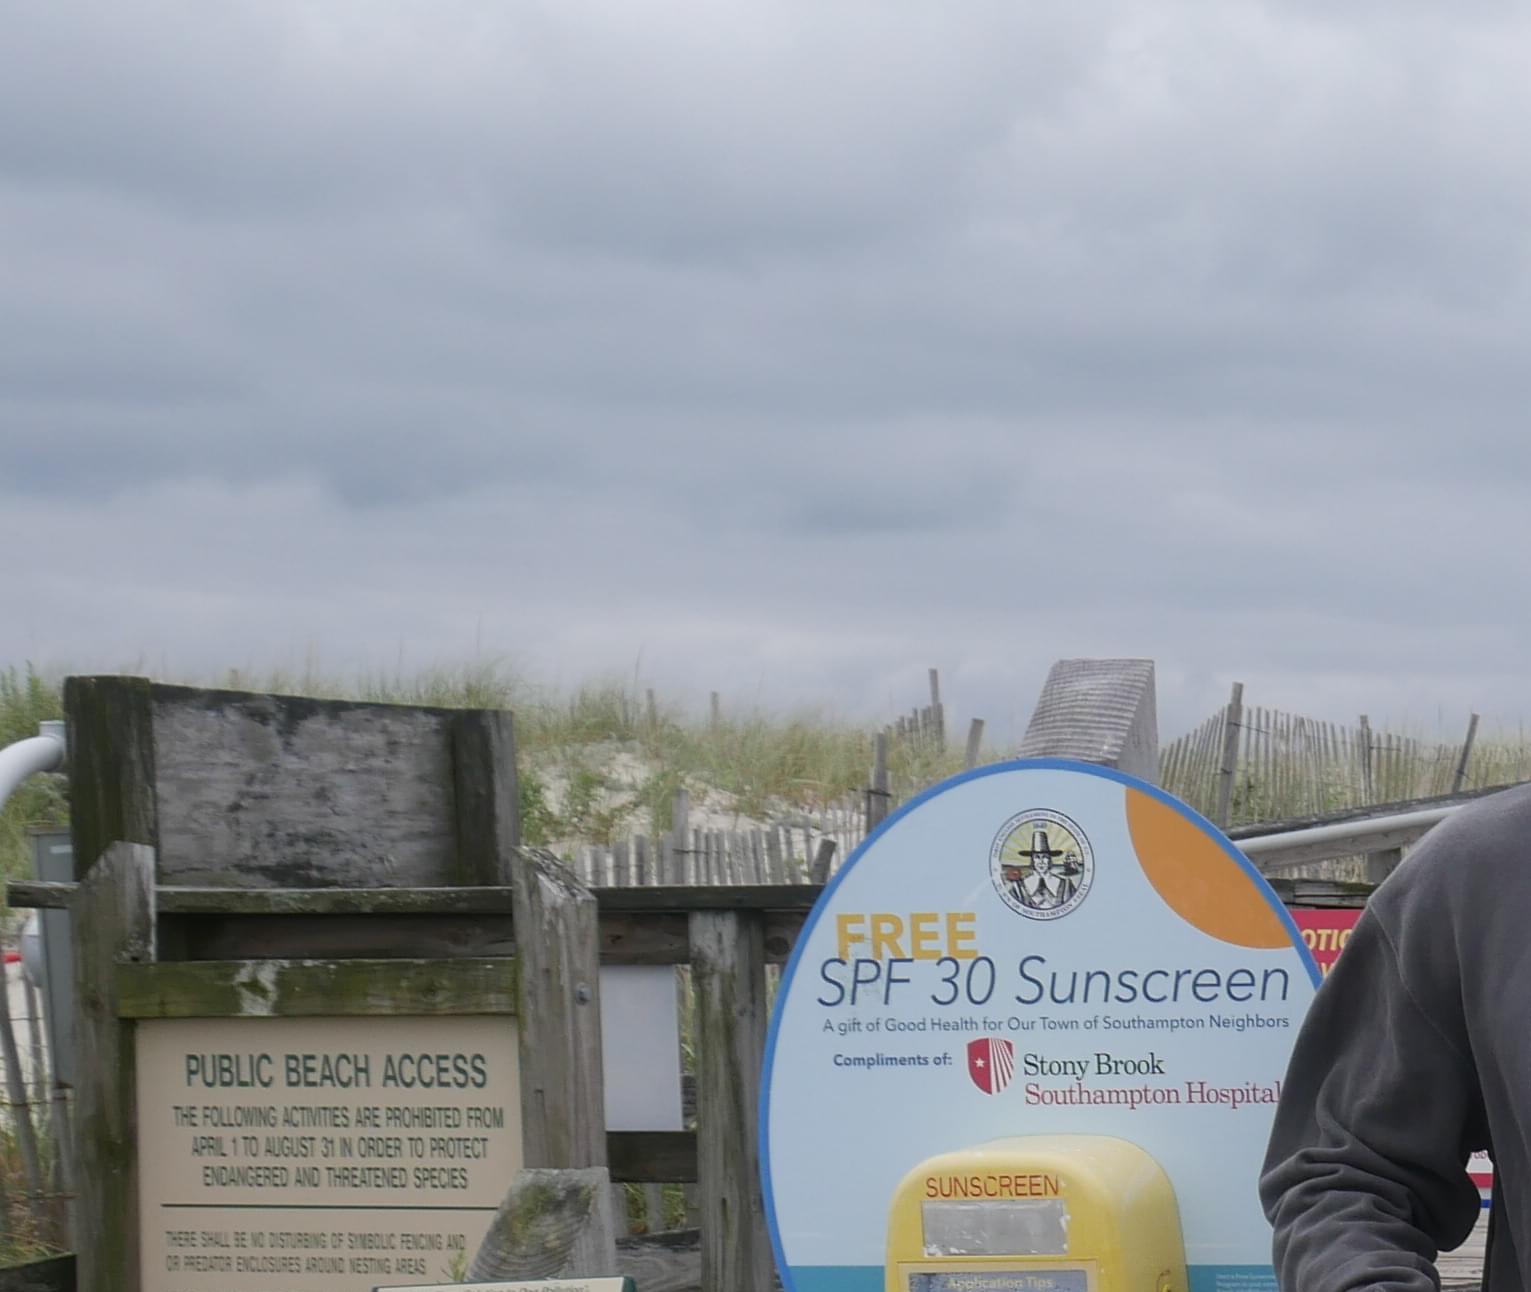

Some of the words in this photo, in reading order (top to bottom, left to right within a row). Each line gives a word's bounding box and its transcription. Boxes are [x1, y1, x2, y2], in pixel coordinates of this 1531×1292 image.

[836, 913, 978, 960] FREE
[817, 958, 915, 1007] SPF
[931, 956, 995, 1005] 30
[1016, 955, 1289, 1005] Sunscreen
[823, 1019, 834, 1032] A
[839, 1018, 862, 1036] gift
[866, 1018, 881, 1031] of
[885, 1018, 926, 1032] Good
[931, 1018, 978, 1032] Health
[983, 1017, 1003, 1031] for
[1008, 1017, 1035, 1031] Our
[1040, 1017, 1078, 1030] Town
[1084, 1016, 1099, 1029] of
[1103, 1016, 1204, 1032] Southampton
[1209, 1014, 1289, 1031] Neighbors
[185, 1054, 273, 1087] PUBLIC
[285, 1054, 370, 1087] BEACH
[383, 1054, 487, 1088] ACCESS
[833, 1054, 929, 1070] Compliments
[933, 1054, 951, 1066] of:
[1024, 1053, 1090, 1080] Stony
[1094, 1052, 1165, 1075] Brook
[1025, 1082, 1180, 1110] Southampton
[1186, 1080, 1282, 1109] Hospital
[173, 1106, 197, 1126] THE
[203, 1107, 277, 1127] FOLLOWING
[283, 1107, 349, 1128] ACTIVITIES
[355, 1107, 380, 1128] ARE
[386, 1107, 461, 1129] PROHIBITED
[467, 1107, 504, 1129] FROM
[192, 1137, 226, 1157] APRIL
[232, 1137, 237, 1157] 1
[242, 1137, 258, 1157] TO
[265, 1137, 316, 1158] AUGUST
[321, 1137, 334, 1158] 31
[340, 1137, 351, 1158] IN
[358, 1137, 402, 1158] ORDER
[408, 1137, 424, 1158] TO
[430, 1137, 488, 1159] PROTECT
[203, 1167, 288, 1187] ENDANGERED
[296, 1167, 320, 1187] AND
[326, 1167, 406, 1188] THREATENED
[414, 1167, 467, 1189] SPECIES
[926, 1175, 1060, 1197] SUNSCREEN
